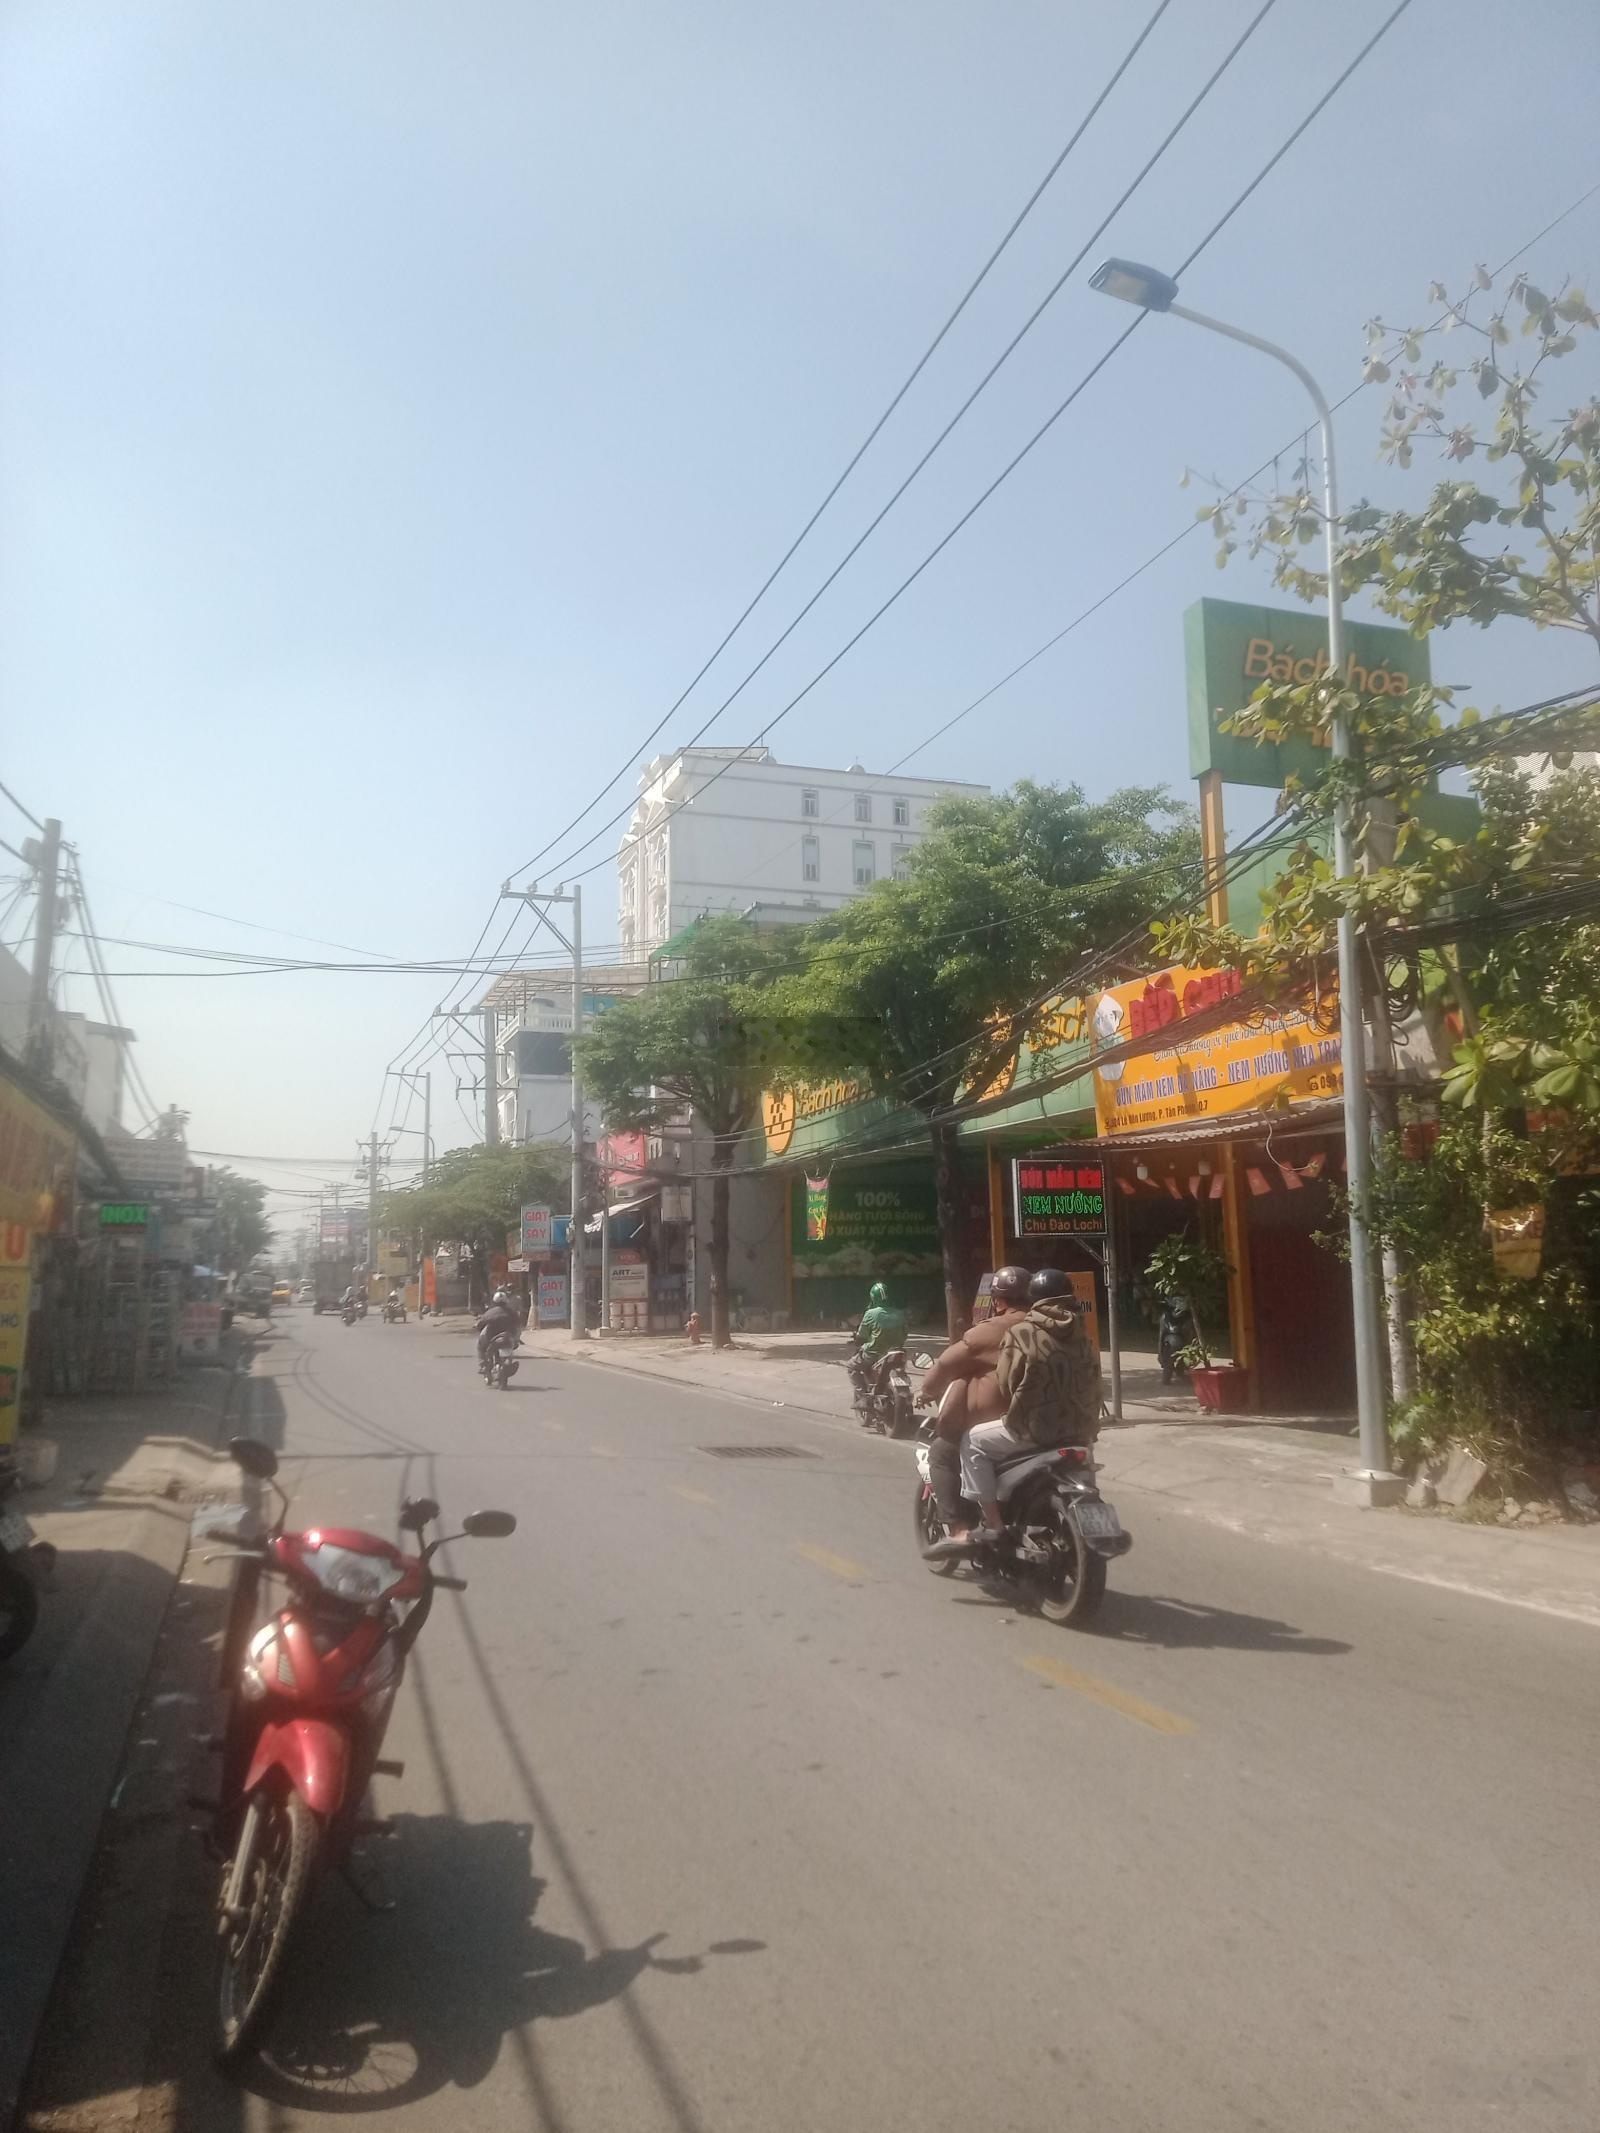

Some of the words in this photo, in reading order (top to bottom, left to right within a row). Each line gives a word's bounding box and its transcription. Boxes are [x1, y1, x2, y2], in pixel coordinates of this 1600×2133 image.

[1344, 652, 1410, 697] hóa
[1228, 1058, 1250, 1083] NEM
[1292, 1044, 1316, 1070] NHA
[854, 1191, 901, 1208] 100%
[1023, 1195, 1052, 1214] NEM
[102, 1205, 145, 1224] INOX
